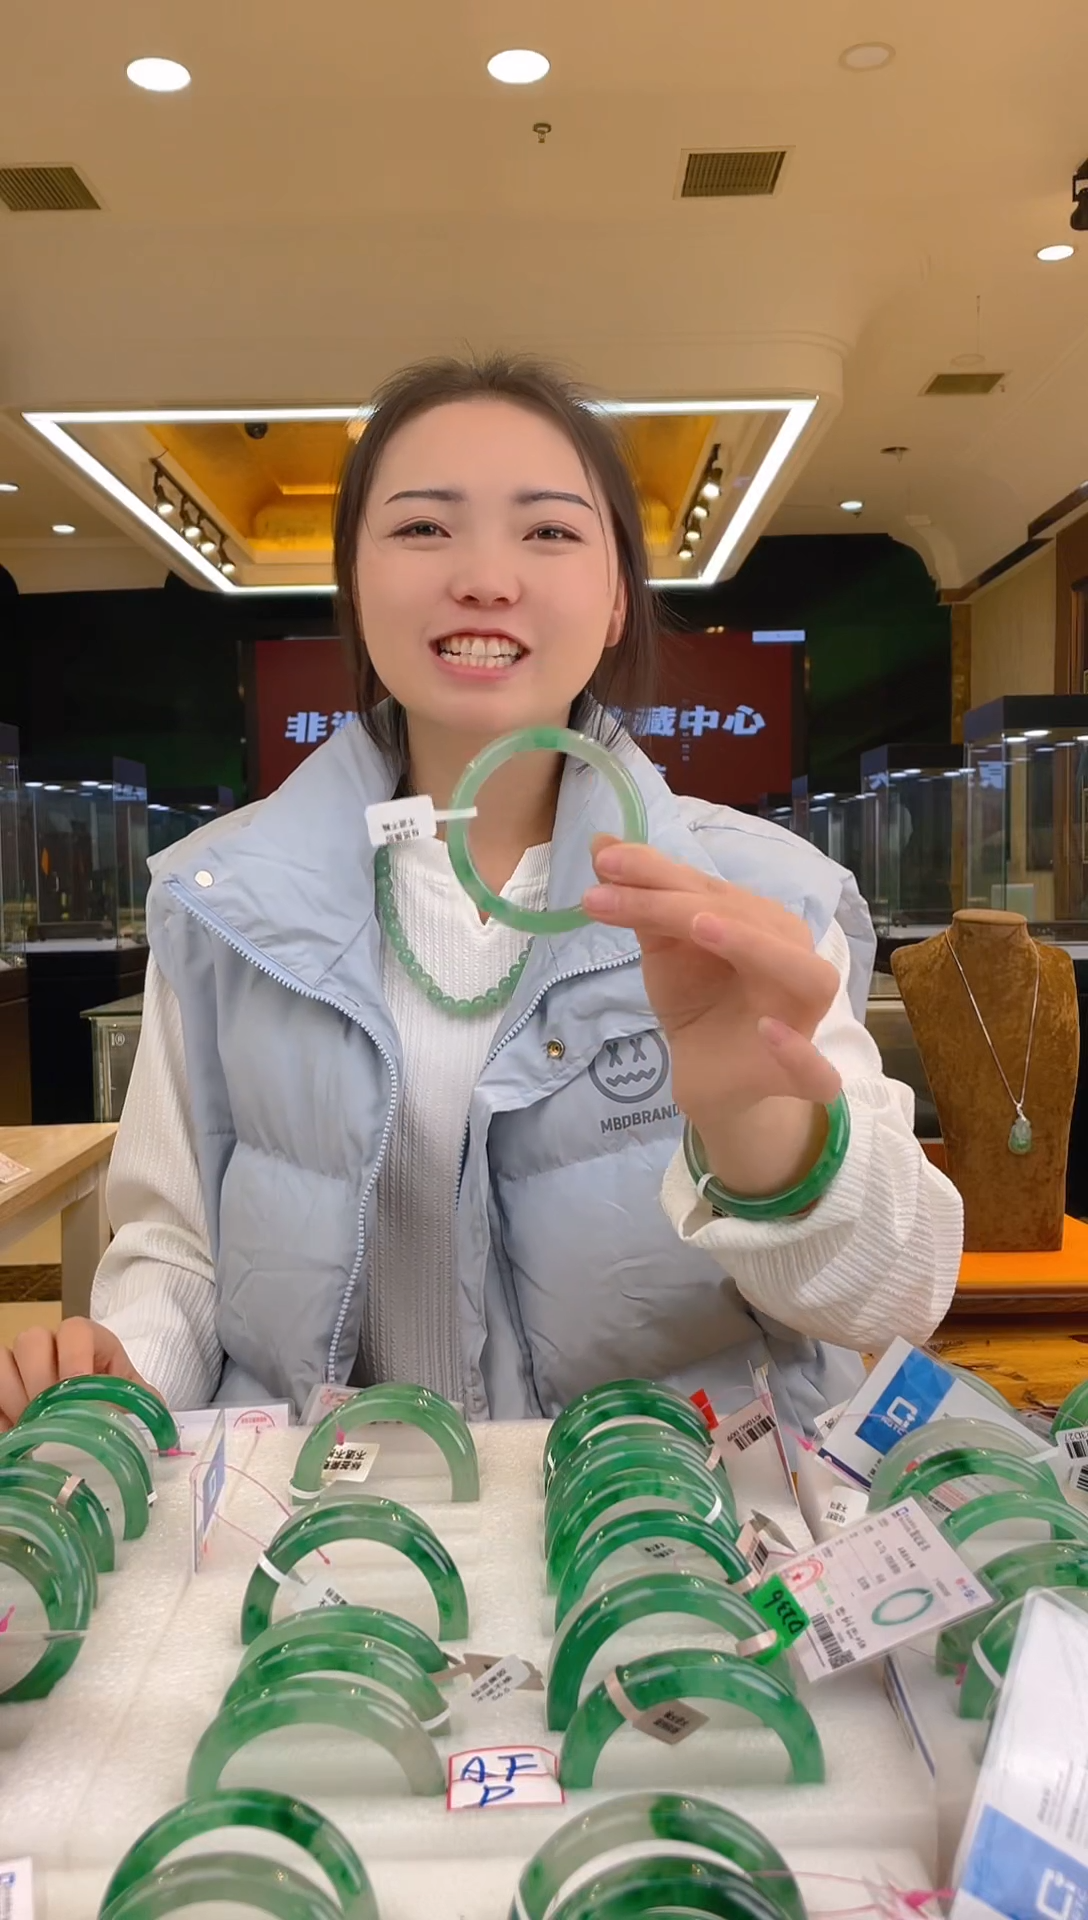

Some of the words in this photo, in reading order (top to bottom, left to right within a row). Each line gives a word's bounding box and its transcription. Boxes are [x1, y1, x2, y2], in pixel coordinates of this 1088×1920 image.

[606, 704, 766, 737] 藏中心
[600, 1103, 680, 1134] MBDBRAND
